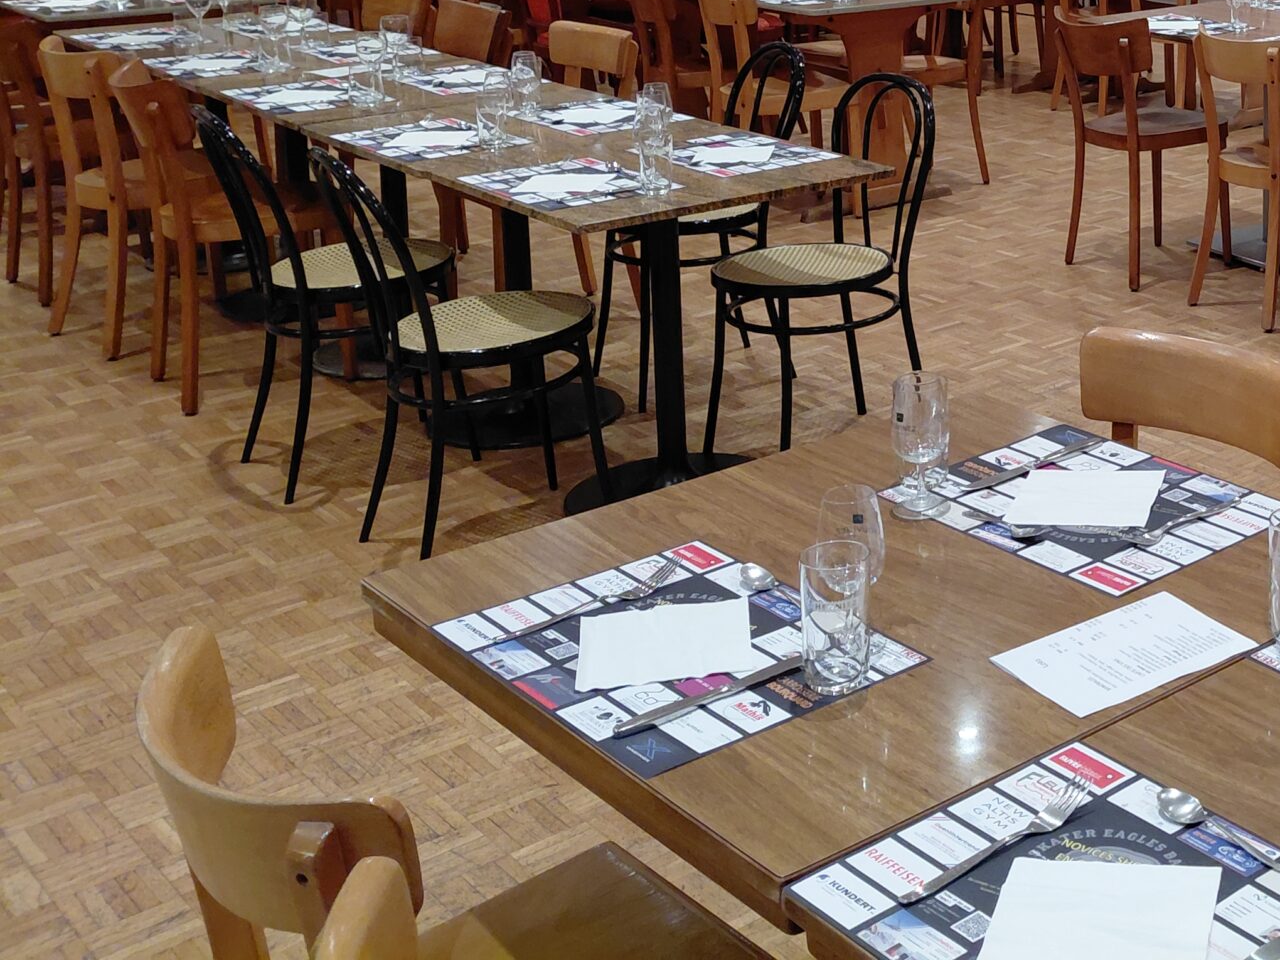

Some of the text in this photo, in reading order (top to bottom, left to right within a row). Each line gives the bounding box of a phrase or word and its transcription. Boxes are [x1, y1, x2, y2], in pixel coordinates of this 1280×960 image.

[1218, 512, 1263, 531] RAIFFEISE
[500, 604, 536, 627] RAIFFEISE
[734, 701, 766, 722] Mathis
[972, 807, 1009, 830] GYM
[981, 802, 1017, 826] ALTIS
[991, 796, 1030, 819] NEW
[1060, 838, 1113, 862] NOVICES
[1102, 827, 1167, 853] EAGLES
